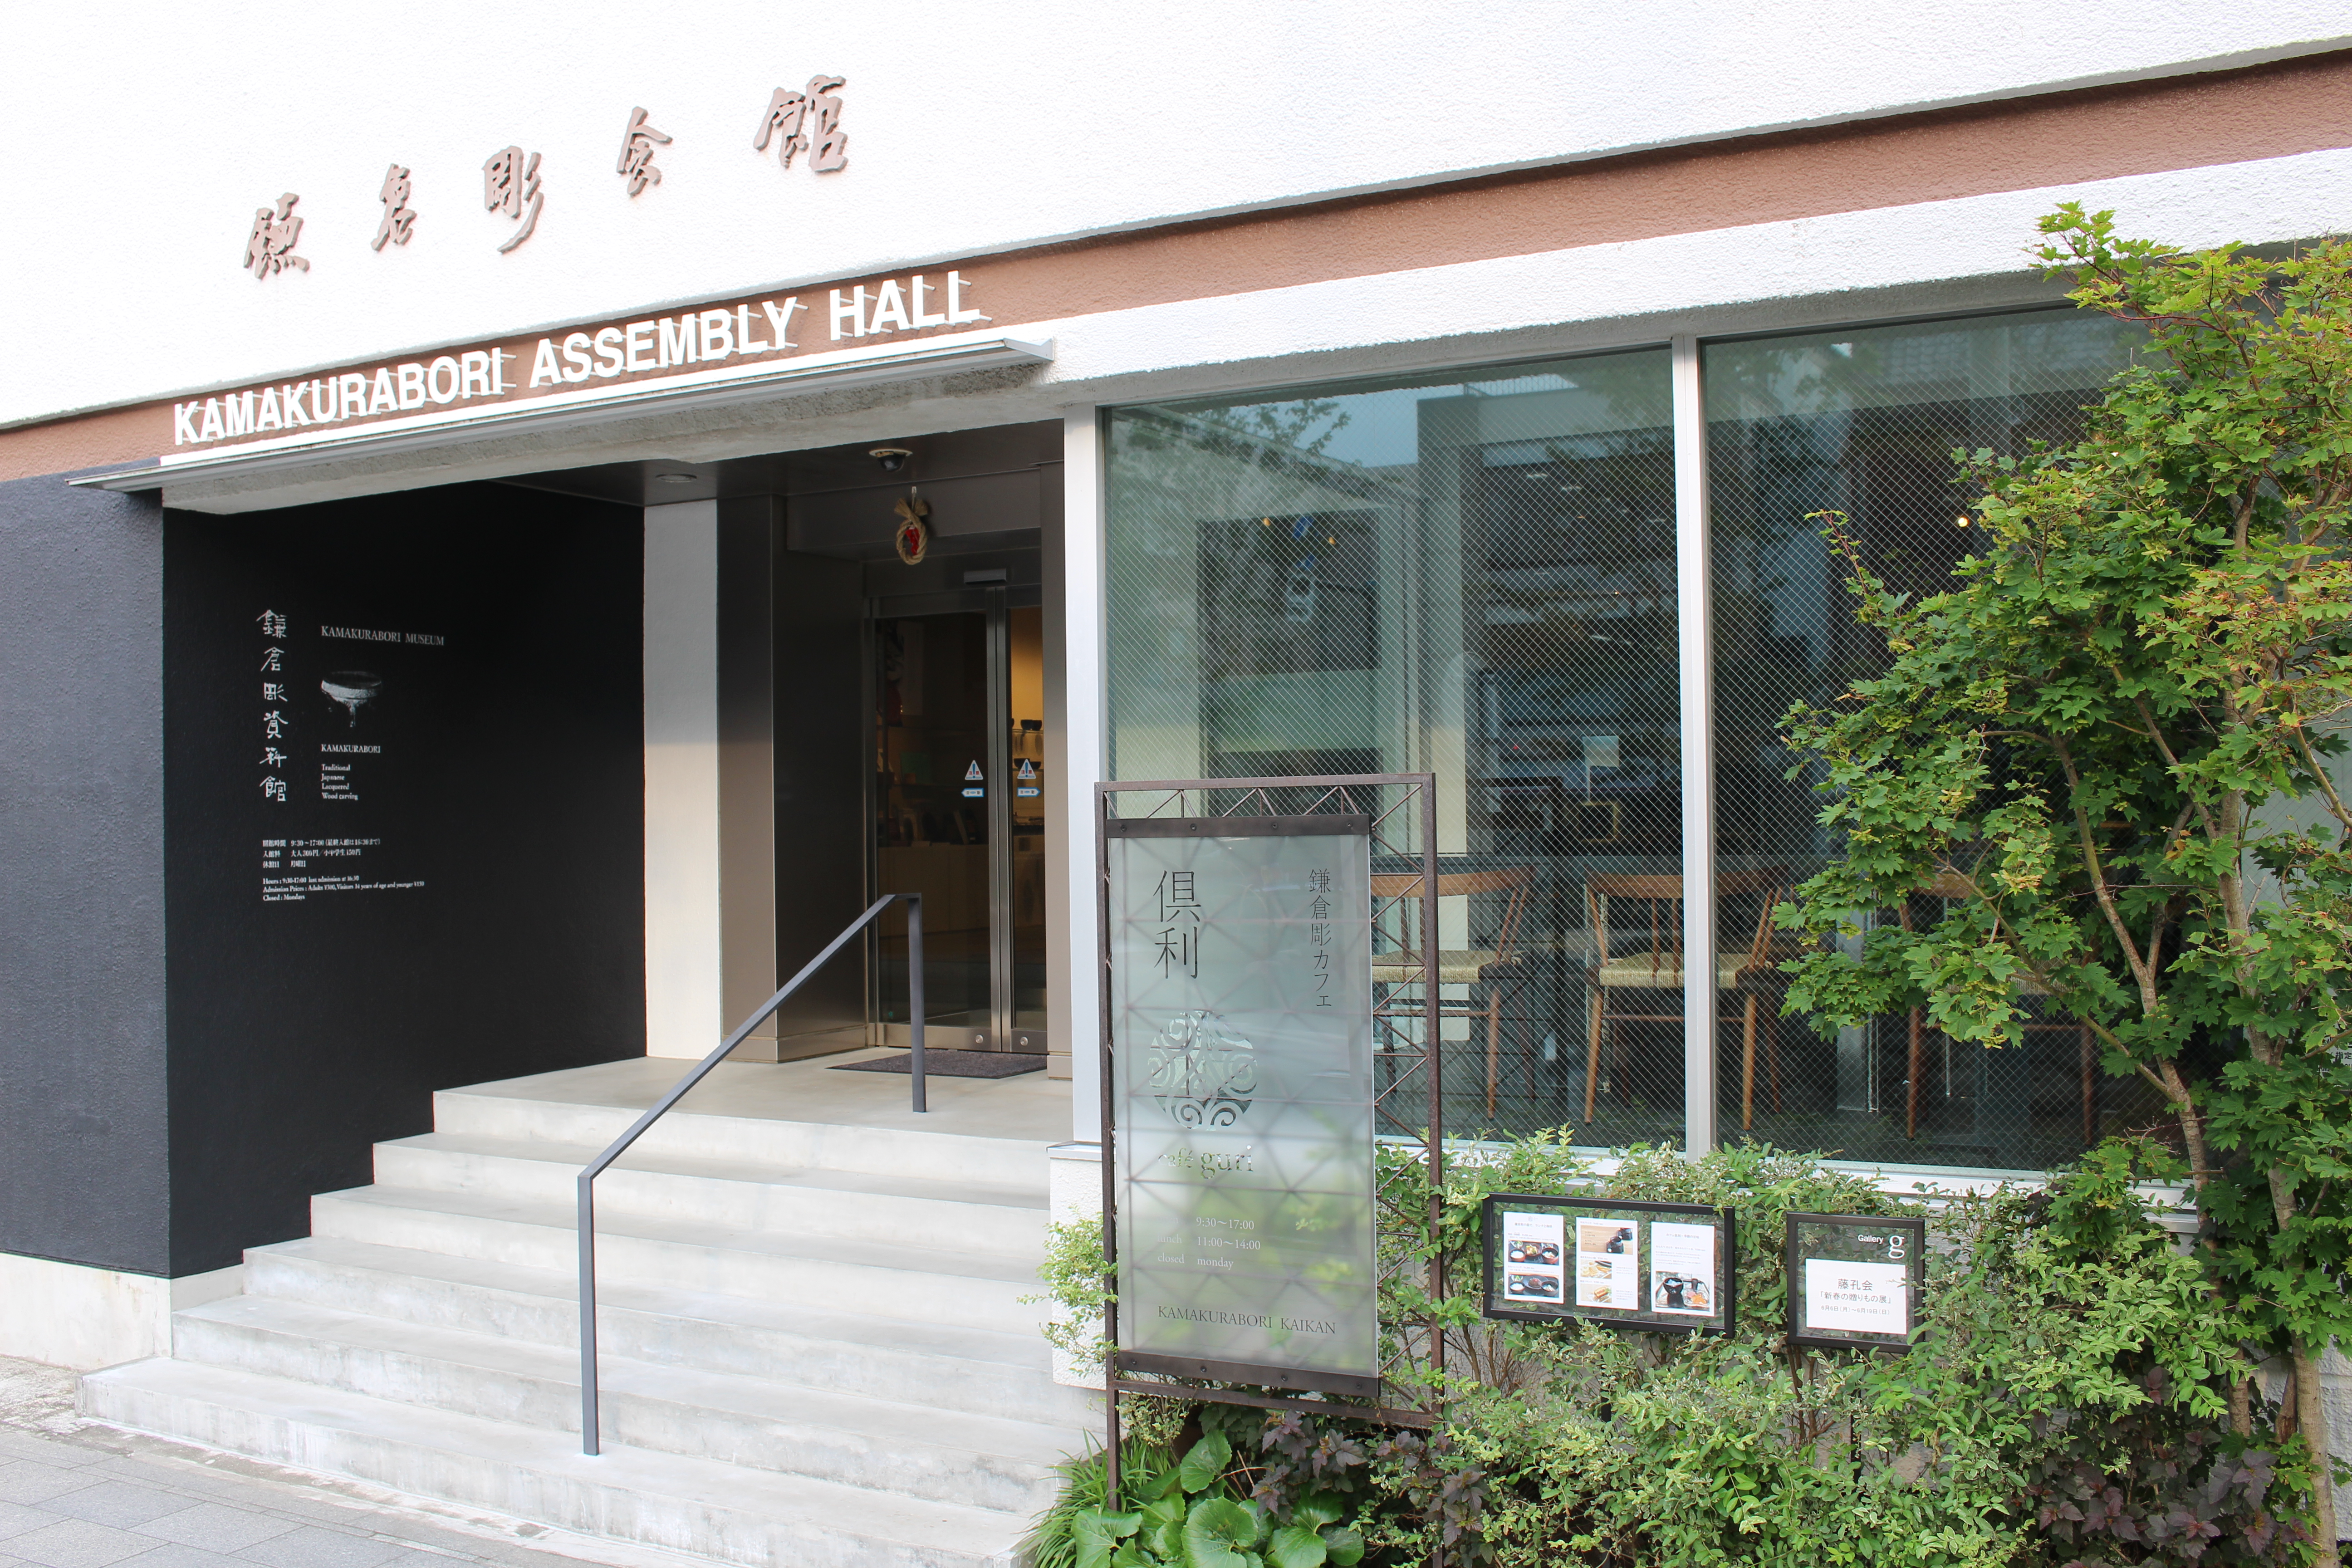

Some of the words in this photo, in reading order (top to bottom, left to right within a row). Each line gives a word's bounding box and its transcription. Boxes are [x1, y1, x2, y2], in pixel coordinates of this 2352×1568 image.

[174, 347, 502, 445] KAMAKURABORI
[529, 296, 798, 388] ASSEMBLY
[830, 270, 980, 341] HALL
[321, 626, 401, 642] KAMAKURABORI
[405, 633, 444, 646] MUSEUM
[256, 609, 288, 802] 鎌倉彫資料館
[321, 744, 381, 753] KAMAKURABORI
[321, 773, 345, 782] Japanese
[322, 783, 349, 791] Lacquered
[339, 792, 358, 801] carving
[284, 893, 305, 901] Mondays
[1308, 868, 1332, 1007] 鎌倉彫カフェ
[1157, 1147, 1194, 1168] café
[1200, 1144, 1254, 1180] guri
[1157, 1233, 1182, 1245] lunch
[1857, 1234, 1884, 1245] Gallery
[1888, 1235, 1905, 1259] g
[1157, 1252, 1185, 1264] closed
[1197, 1256, 1234, 1270] monday
[1837, 1278, 1873, 1291] 藤孔会
[1157, 1306, 1273, 1329] KAMAKURABORI
[1280, 1318, 1336, 1334] KAIKAN
